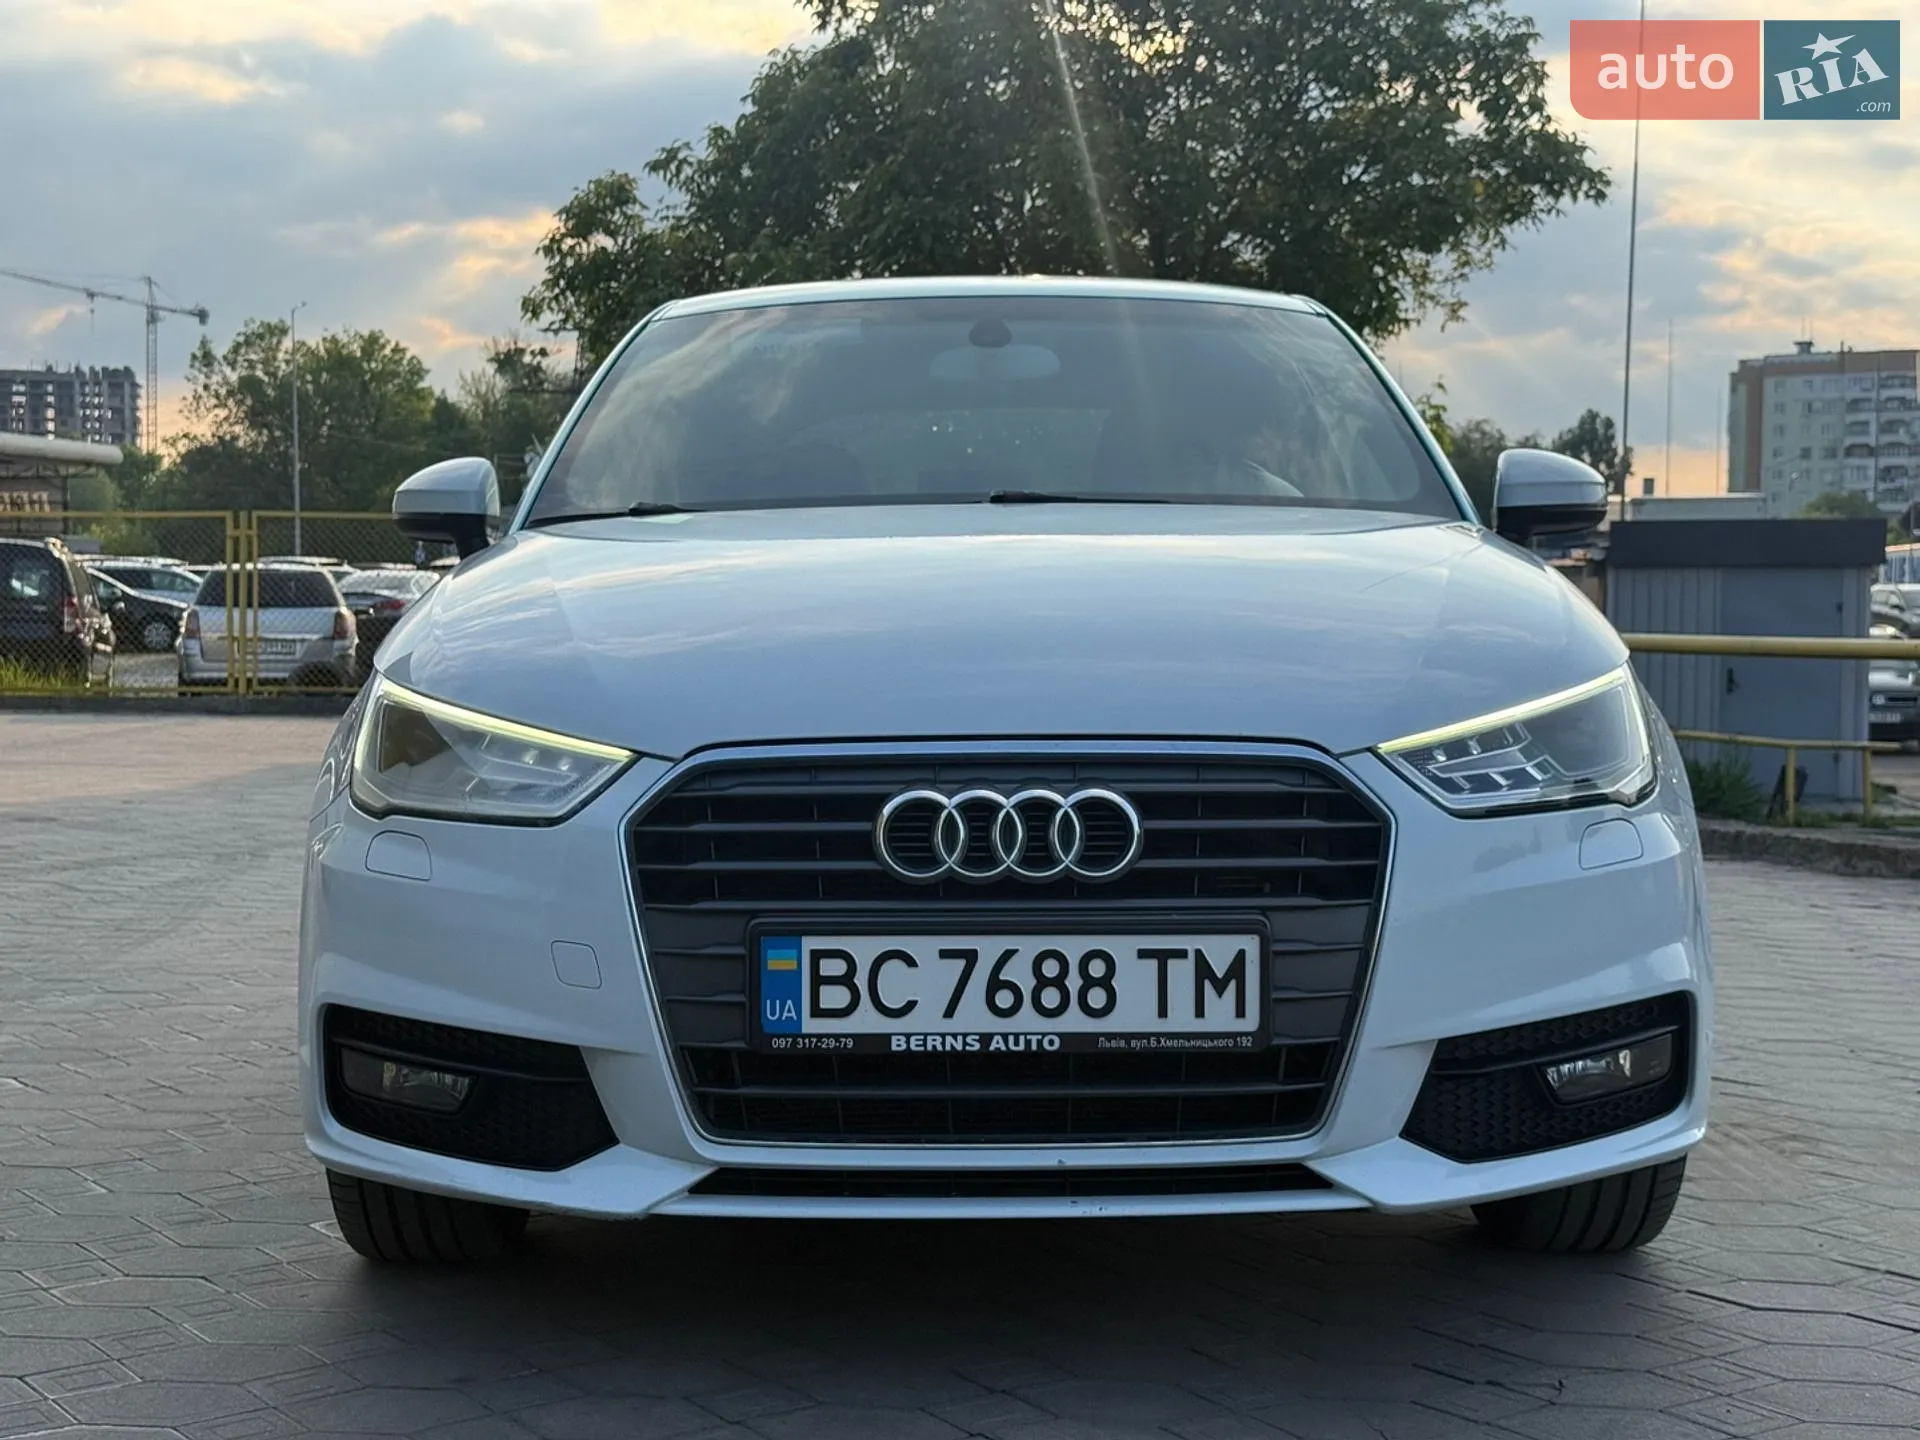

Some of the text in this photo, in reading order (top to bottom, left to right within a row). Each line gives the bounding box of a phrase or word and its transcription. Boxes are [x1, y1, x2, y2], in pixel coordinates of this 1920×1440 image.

[809, 948, 1247, 1019] BC 7688 TM
[766, 999, 798, 1022] UA
[771, 1037, 854, 1049] 097 317-29-79
[890, 1034, 1061, 1051] BERNS AUTO
[1236, 1036, 1253, 1047] 192
